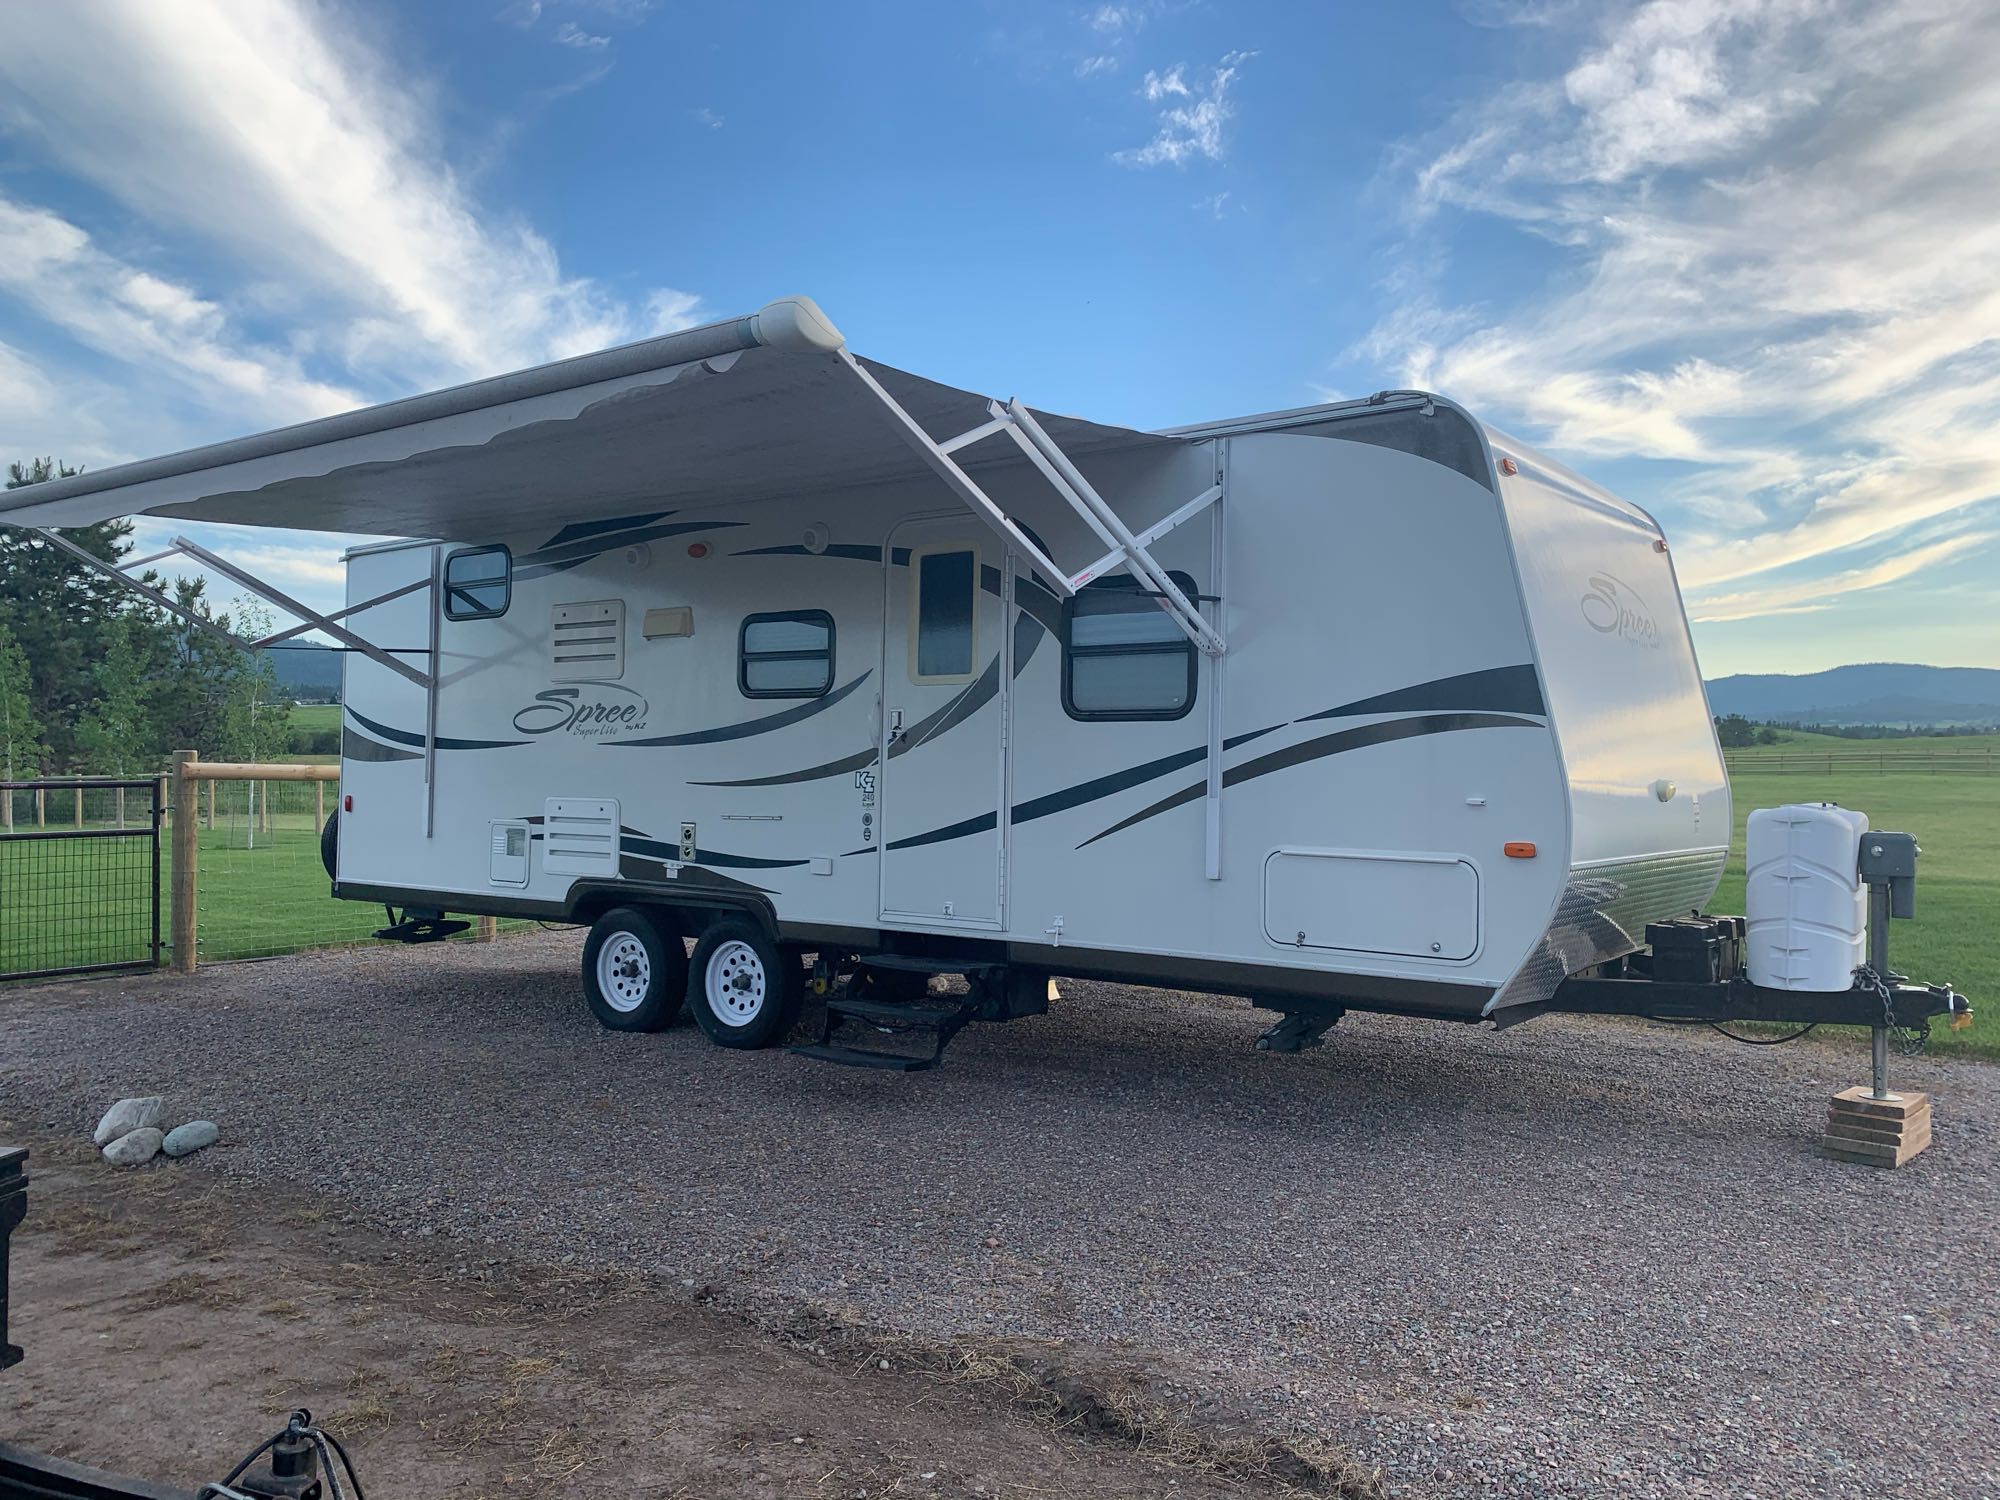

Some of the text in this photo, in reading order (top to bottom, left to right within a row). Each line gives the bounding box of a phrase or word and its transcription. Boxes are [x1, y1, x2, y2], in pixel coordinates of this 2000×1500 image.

[1581, 577, 1652, 638] Spree
[513, 688, 638, 734] Spree
[573, 724, 599, 739] Super
[855, 771, 875, 793] KZ
